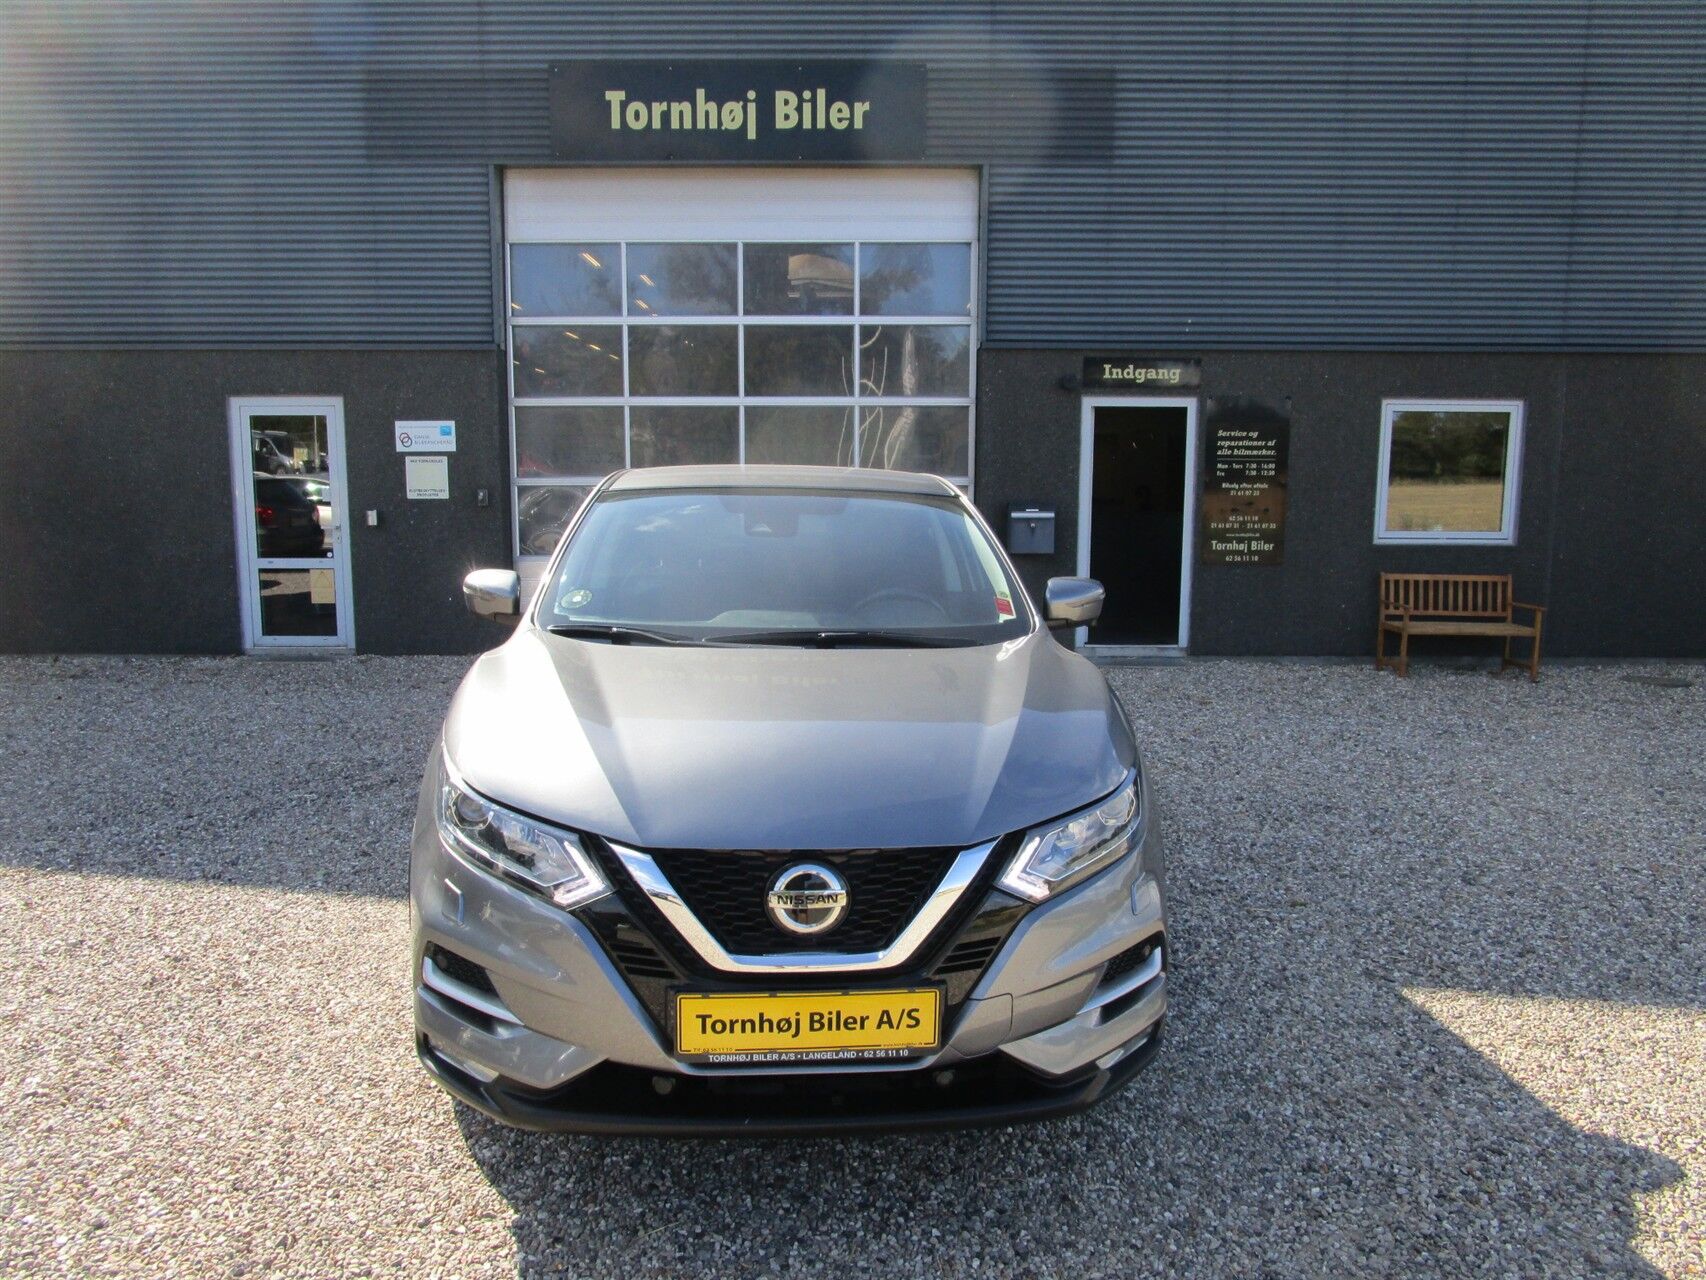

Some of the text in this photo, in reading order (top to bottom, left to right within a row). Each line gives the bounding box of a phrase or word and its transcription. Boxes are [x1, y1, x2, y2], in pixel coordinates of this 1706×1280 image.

[605, 88, 870, 140] Tornhøj Biler
[1103, 364, 1181, 383] Indgang
[1217, 429, 1247, 437] Service
[1211, 541, 1274, 553] Tornhøj Biler
[777, 894, 838, 905] NISSAN
[695, 1007, 921, 1039] Tornhøj Biler A/S
[709, 1054, 751, 1062] TORNHØJ
[753, 1053, 779, 1061] BILER
[781, 1052, 795, 1060] A/S
[803, 1051, 857, 1060] LANGELAND
[900, 1049, 909, 1057] 10
